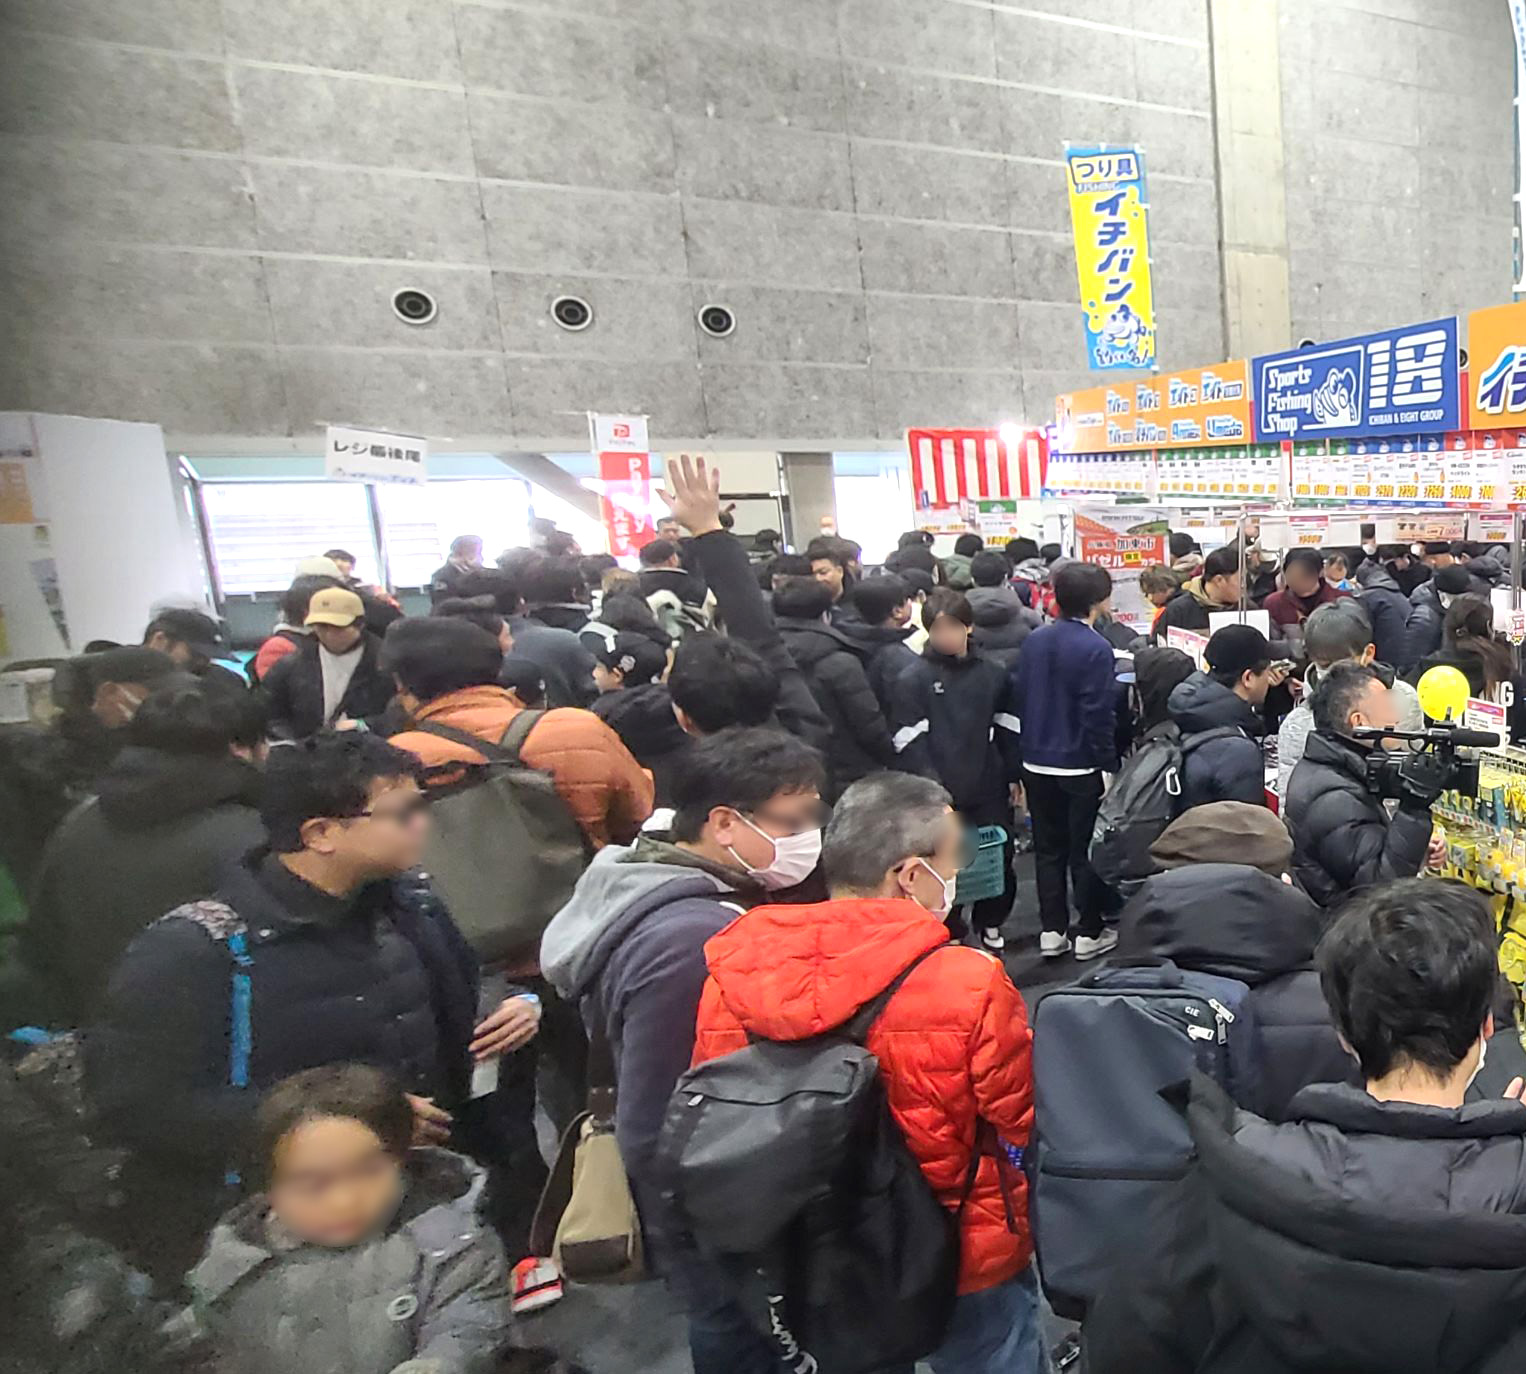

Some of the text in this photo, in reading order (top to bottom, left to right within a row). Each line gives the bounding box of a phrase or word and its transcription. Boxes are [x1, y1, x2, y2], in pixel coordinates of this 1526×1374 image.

[1076, 157, 1134, 179] つり具
[1094, 191, 1135, 302] イチバン
[1268, 364, 1312, 391] Sports
[1267, 389, 1312, 414] Fishing
[1267, 413, 1298, 437] Shop
[1369, 414, 1393, 425] ICHIBAN
[1400, 411, 1419, 423] EIGHT
[1420, 409, 1444, 421] GROUP
